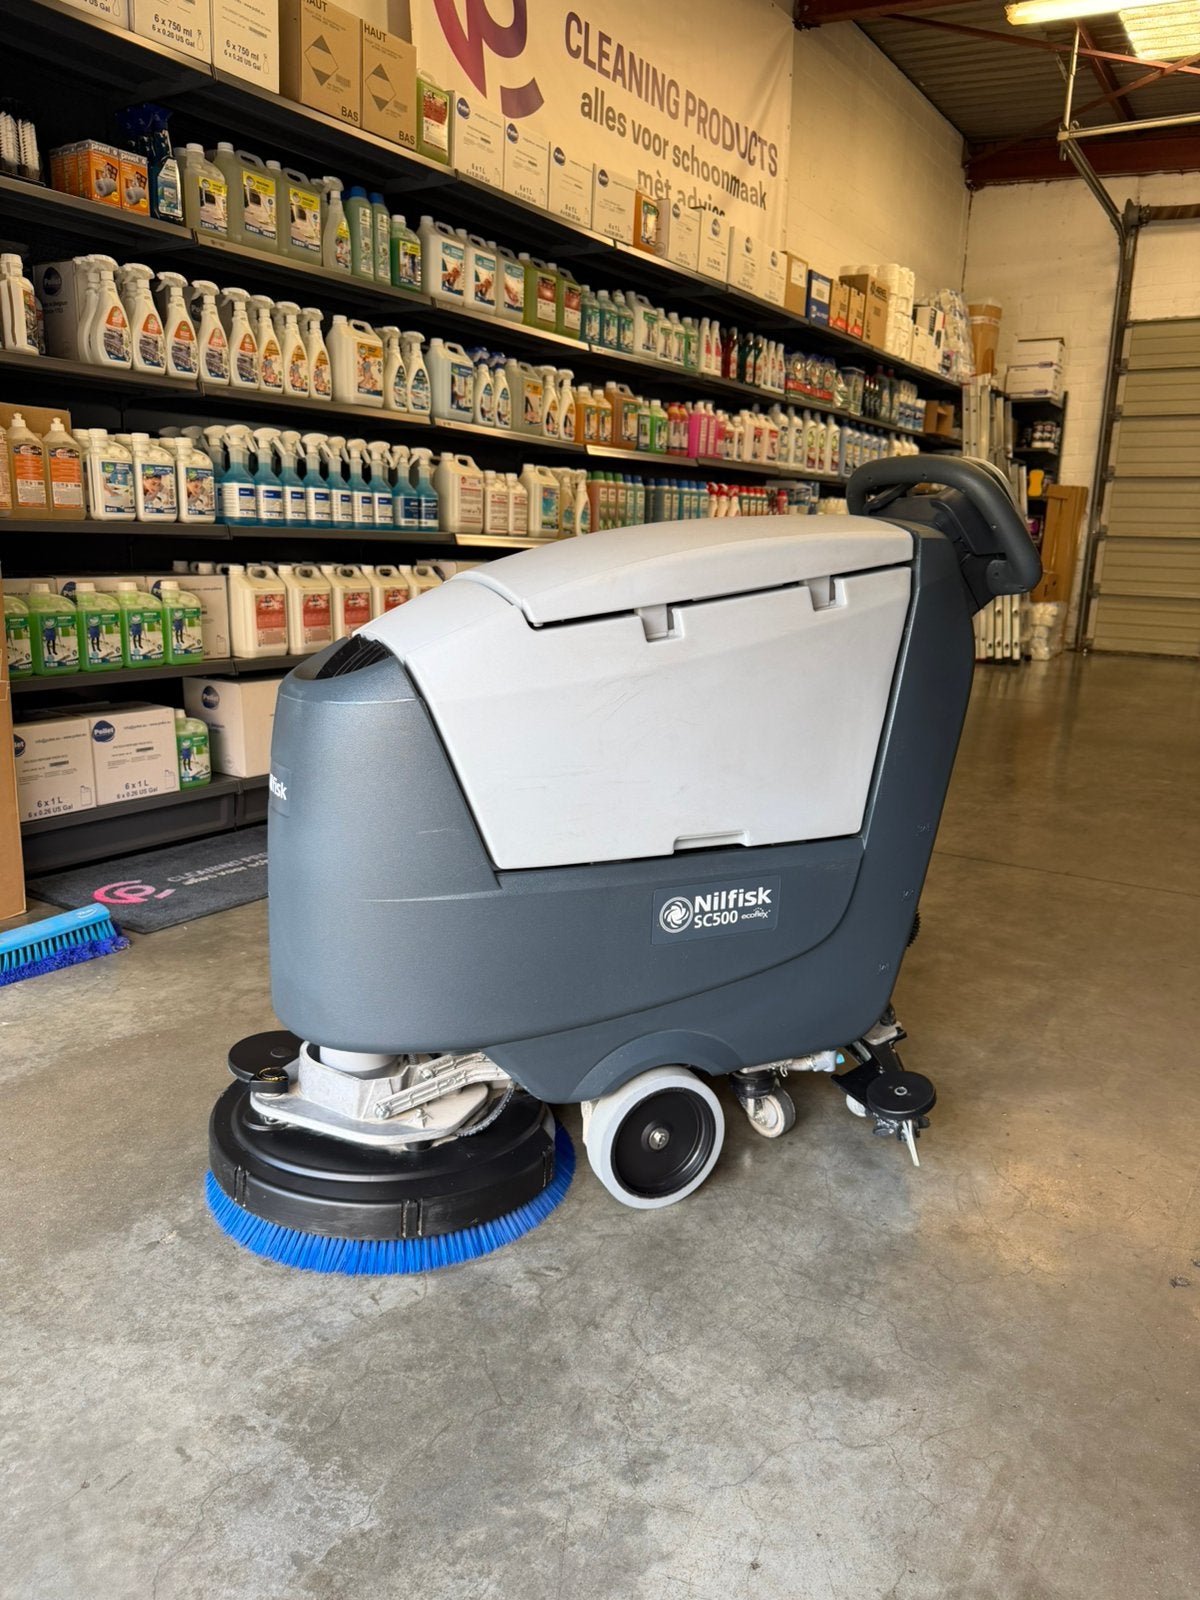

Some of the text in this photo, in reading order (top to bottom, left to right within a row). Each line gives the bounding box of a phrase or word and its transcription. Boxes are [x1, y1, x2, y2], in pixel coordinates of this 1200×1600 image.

[167, 19, 181, 32] 750
[183, 28, 192, 37] ml
[364, 23, 386, 42] HAUT
[237, 44, 249, 56] 750
[565, 11, 778, 177] CLEANING PRODUCTS
[341, 106, 359, 122] BAS
[398, 130, 415, 146] BAS
[580, 86, 767, 211] alles voor schoonmaak
[638, 169, 725, 217] mèt advi
[94, 727, 114, 737] Pollet
[269, 773, 287, 800] lfisk
[694, 887, 772, 913] Nilfisk
[694, 910, 738, 928] SC500
